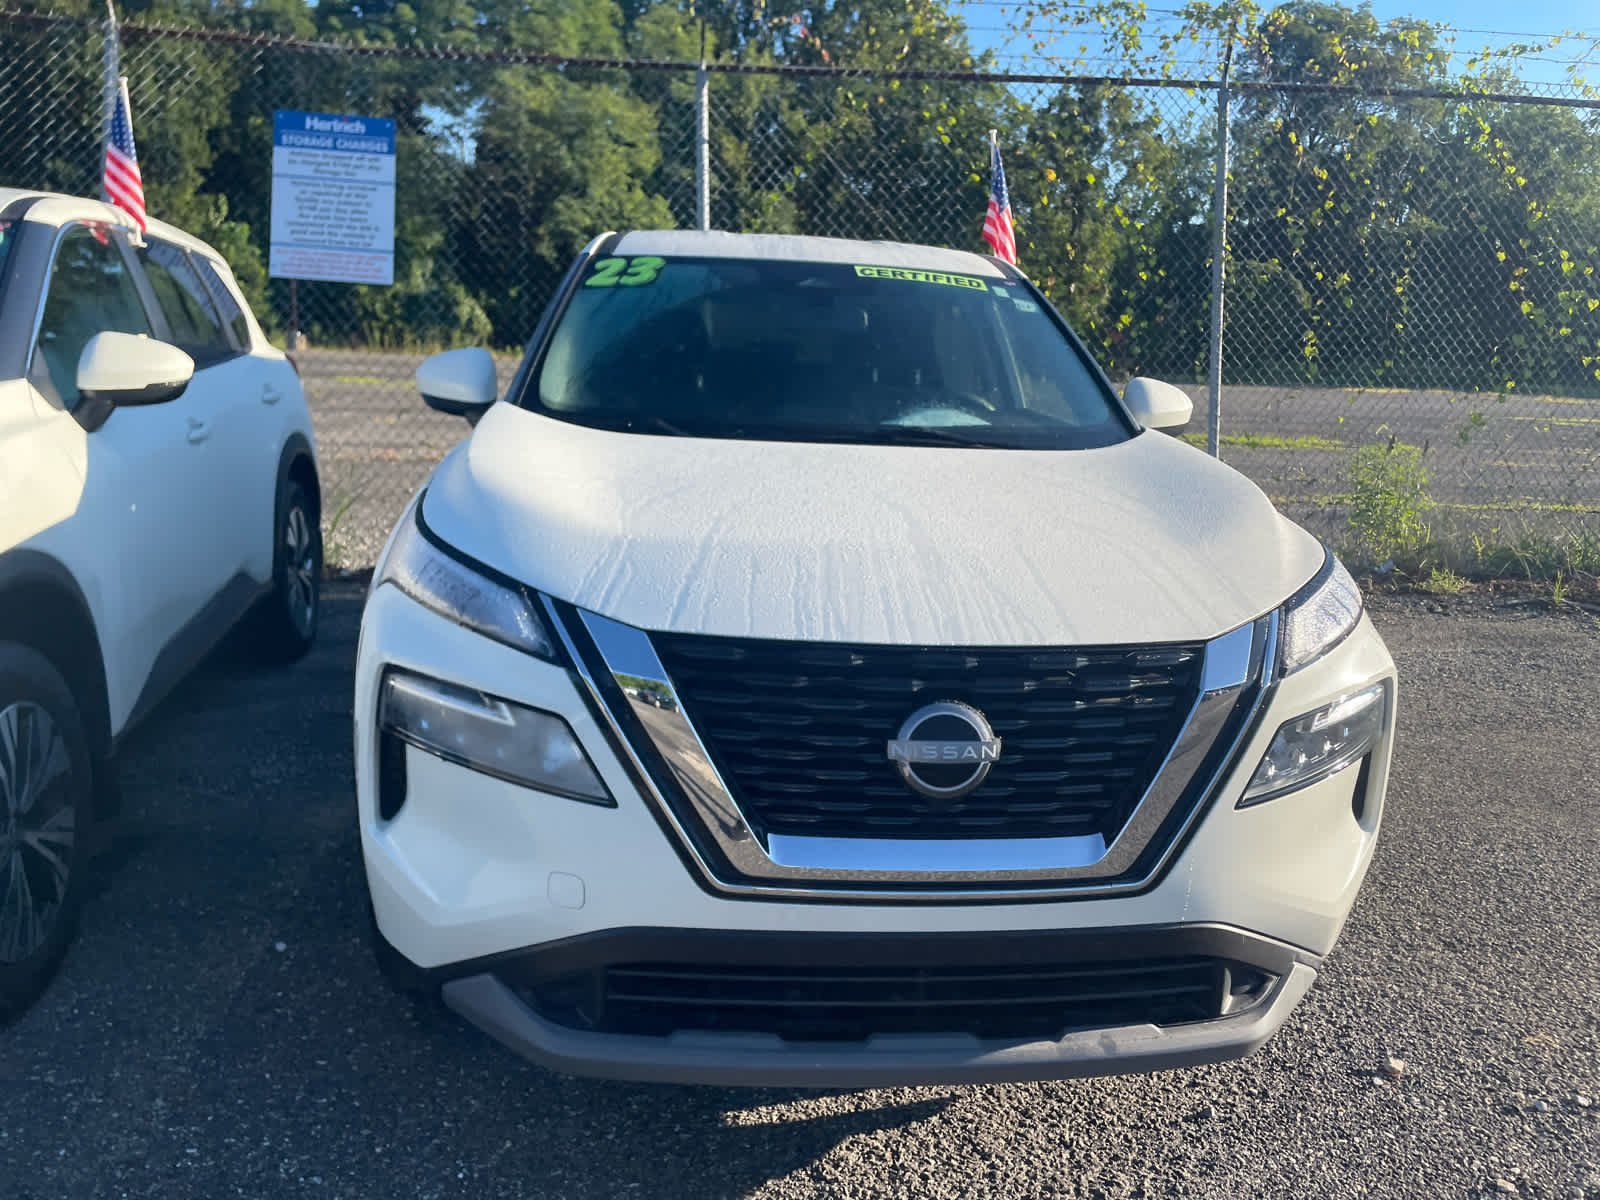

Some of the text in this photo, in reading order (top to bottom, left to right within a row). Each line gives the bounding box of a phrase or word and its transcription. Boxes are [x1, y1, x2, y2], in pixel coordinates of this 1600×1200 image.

[304, 115, 367, 135] Hertrich
[584, 256, 667, 287] 23
[858, 267, 983, 289] CERTIFIED
[891, 743, 998, 760] NISSAN
